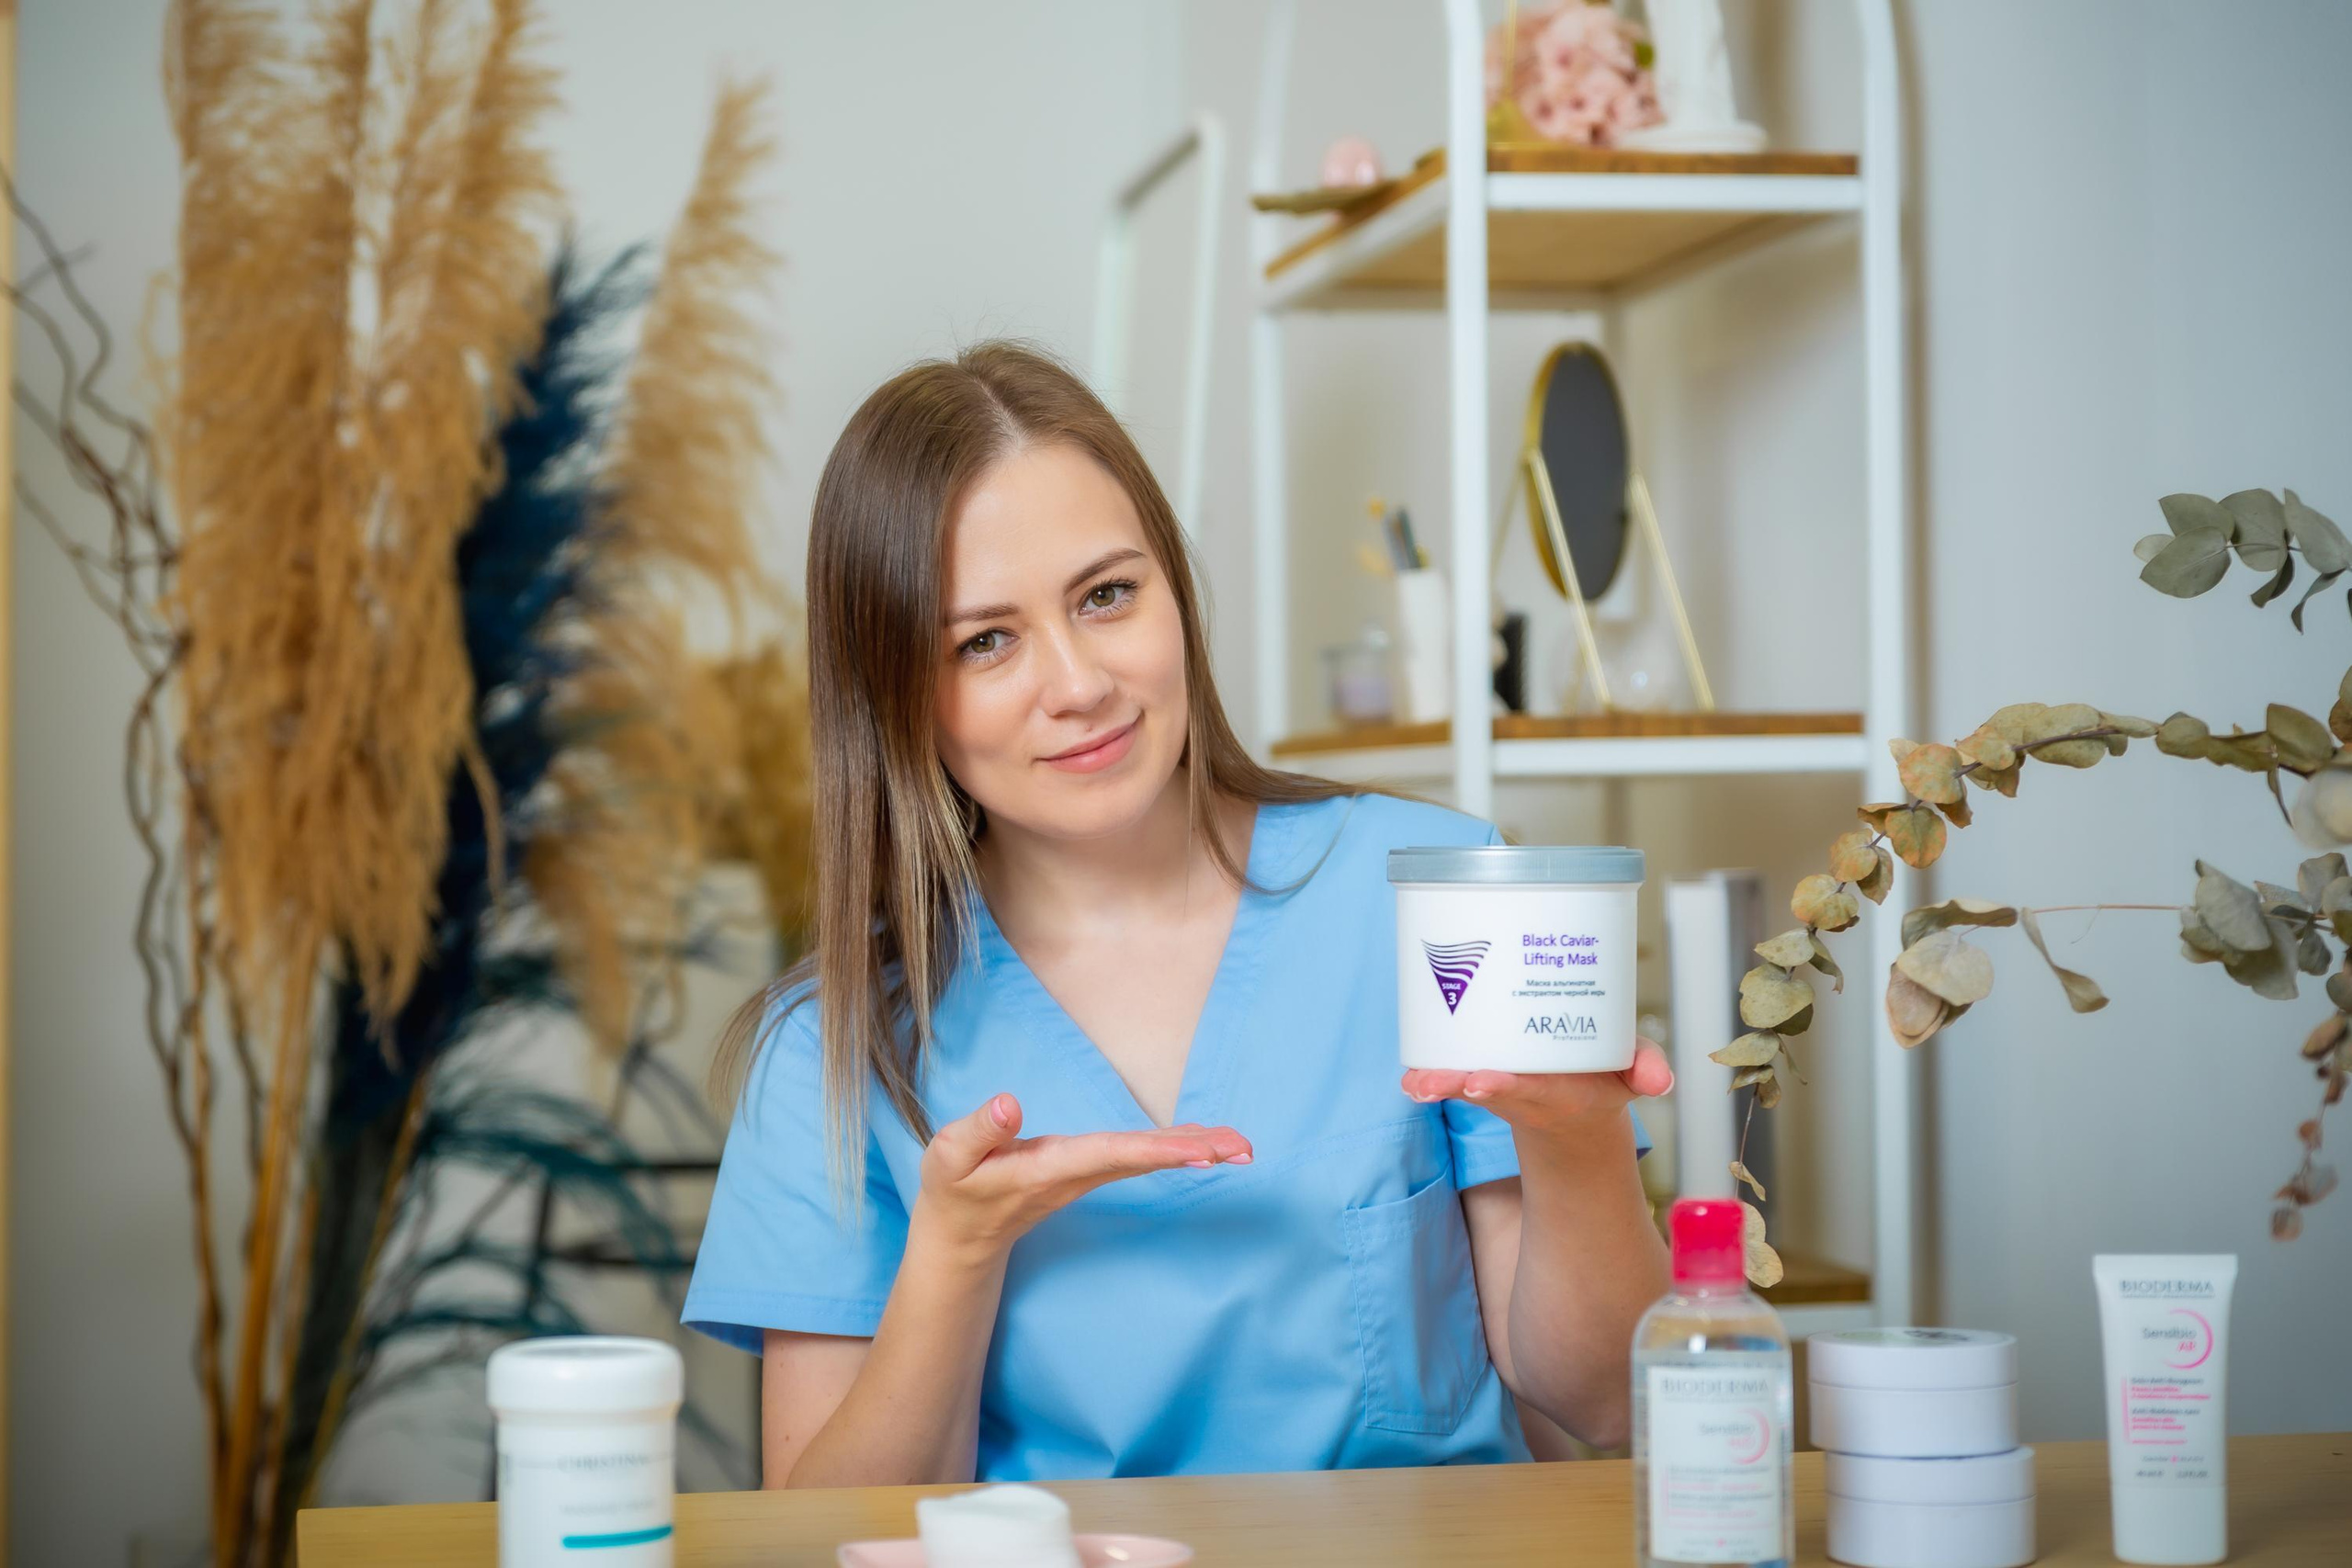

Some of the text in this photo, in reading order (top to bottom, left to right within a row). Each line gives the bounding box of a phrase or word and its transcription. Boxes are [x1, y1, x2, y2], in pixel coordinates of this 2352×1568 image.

[1522, 934, 1600, 947] Black Caviar-
[1524, 952, 1598, 968] Lifting Mask
[1448, 992, 1457, 1005] 3
[1524, 1012, 1597, 1033] ARAVIA
[2120, 1280, 2214, 1292] BIODERMA
